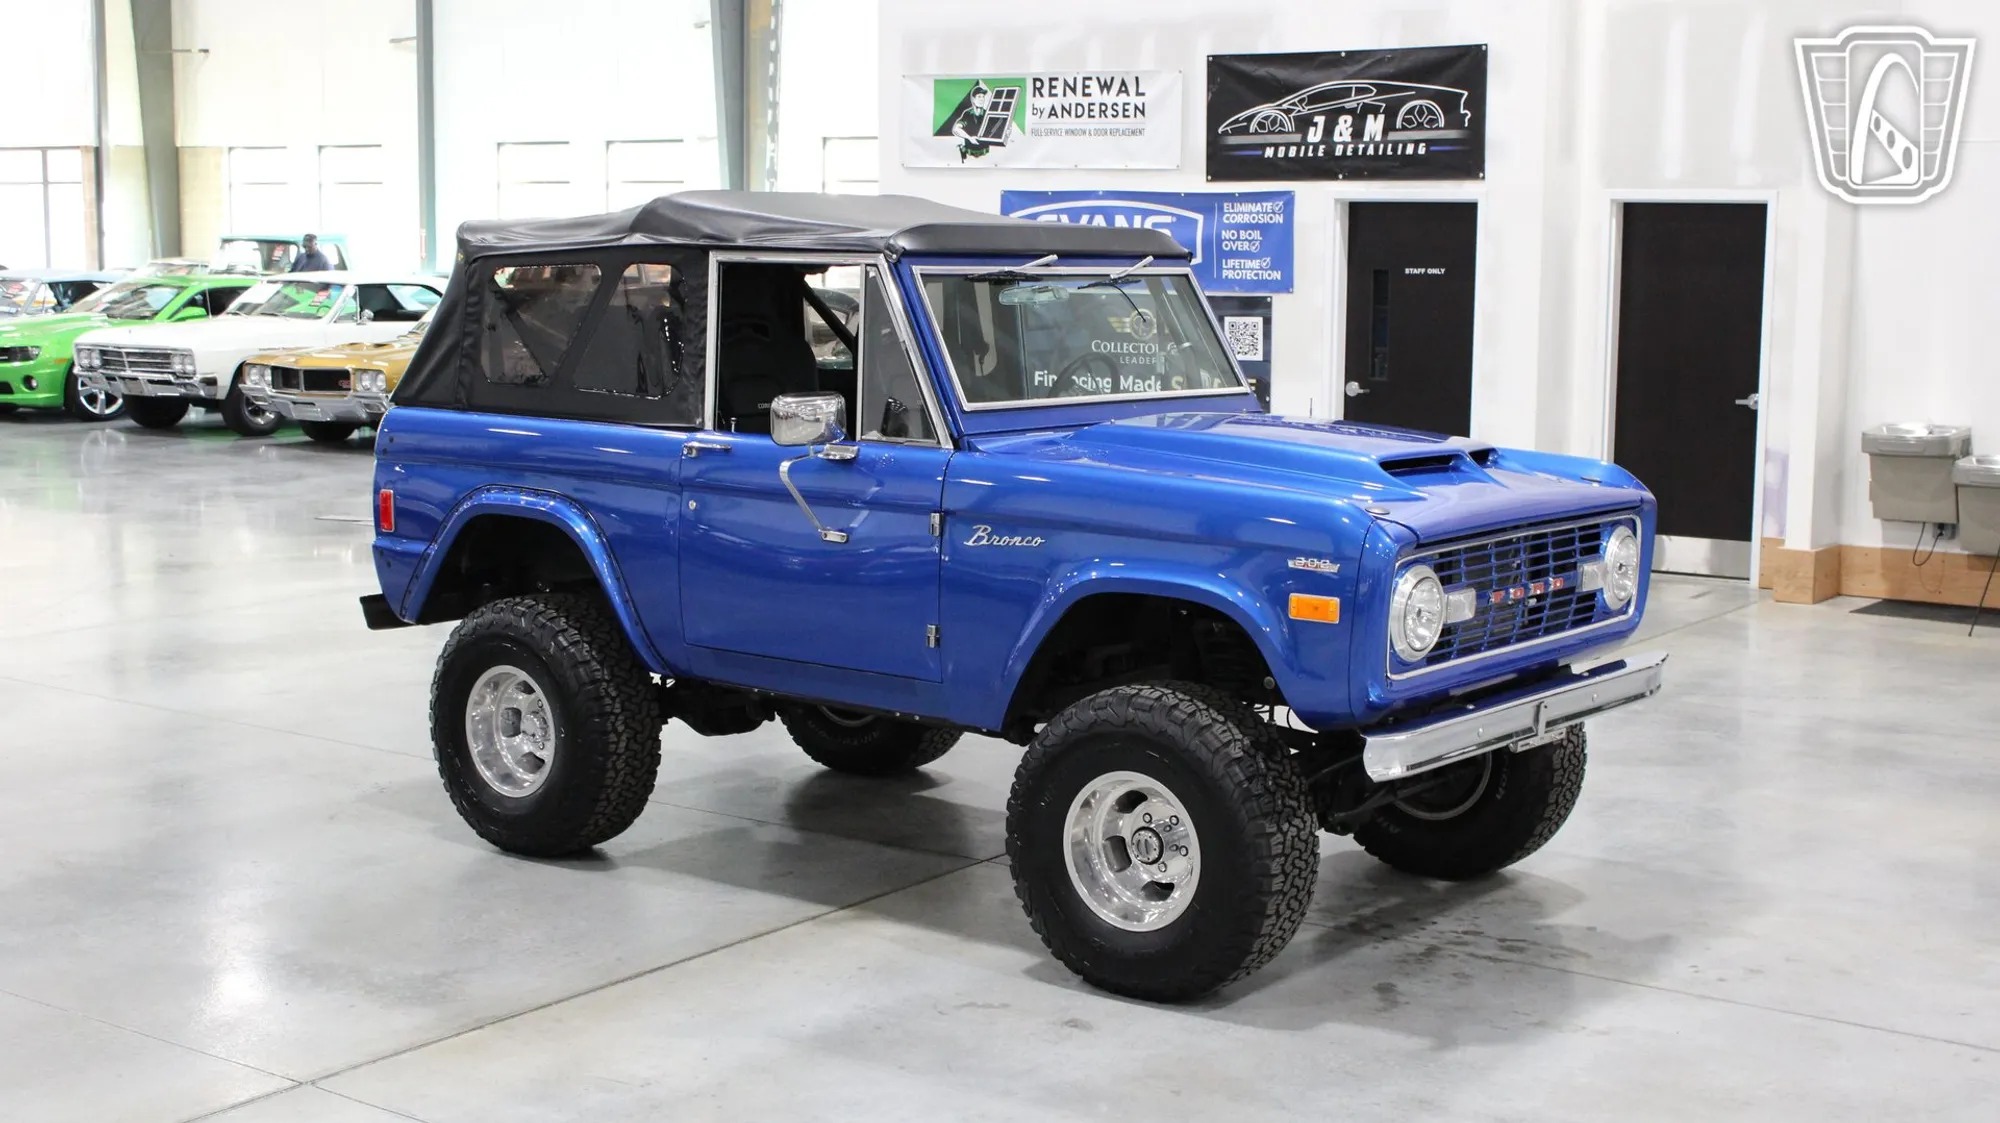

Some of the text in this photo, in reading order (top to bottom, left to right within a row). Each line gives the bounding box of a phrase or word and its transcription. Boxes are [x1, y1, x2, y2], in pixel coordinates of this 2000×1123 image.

[1032, 76, 1146, 98] RENEWAL
[1032, 102, 1146, 119] by ANDERSEN
[1064, 127, 1087, 137] WINDOW
[1093, 127, 1108, 137] DOOR
[1109, 127, 1145, 137] REPLACEMENT
[1306, 114, 1386, 143] J & M
[1264, 142, 1426, 158] MOBILE DETAILING
[1223, 202, 1273, 213] ELIMINATE
[1223, 213, 1284, 224] CORROSION
[1221, 229, 1263, 240] NO BOIL
[1222, 241, 1250, 251] OVER
[1222, 258, 1261, 269] LIFETIME
[1222, 269, 1282, 280] PROTECTION
[963, 525, 1046, 547] Bronco
[1488, 577, 1564, 605] FORD
